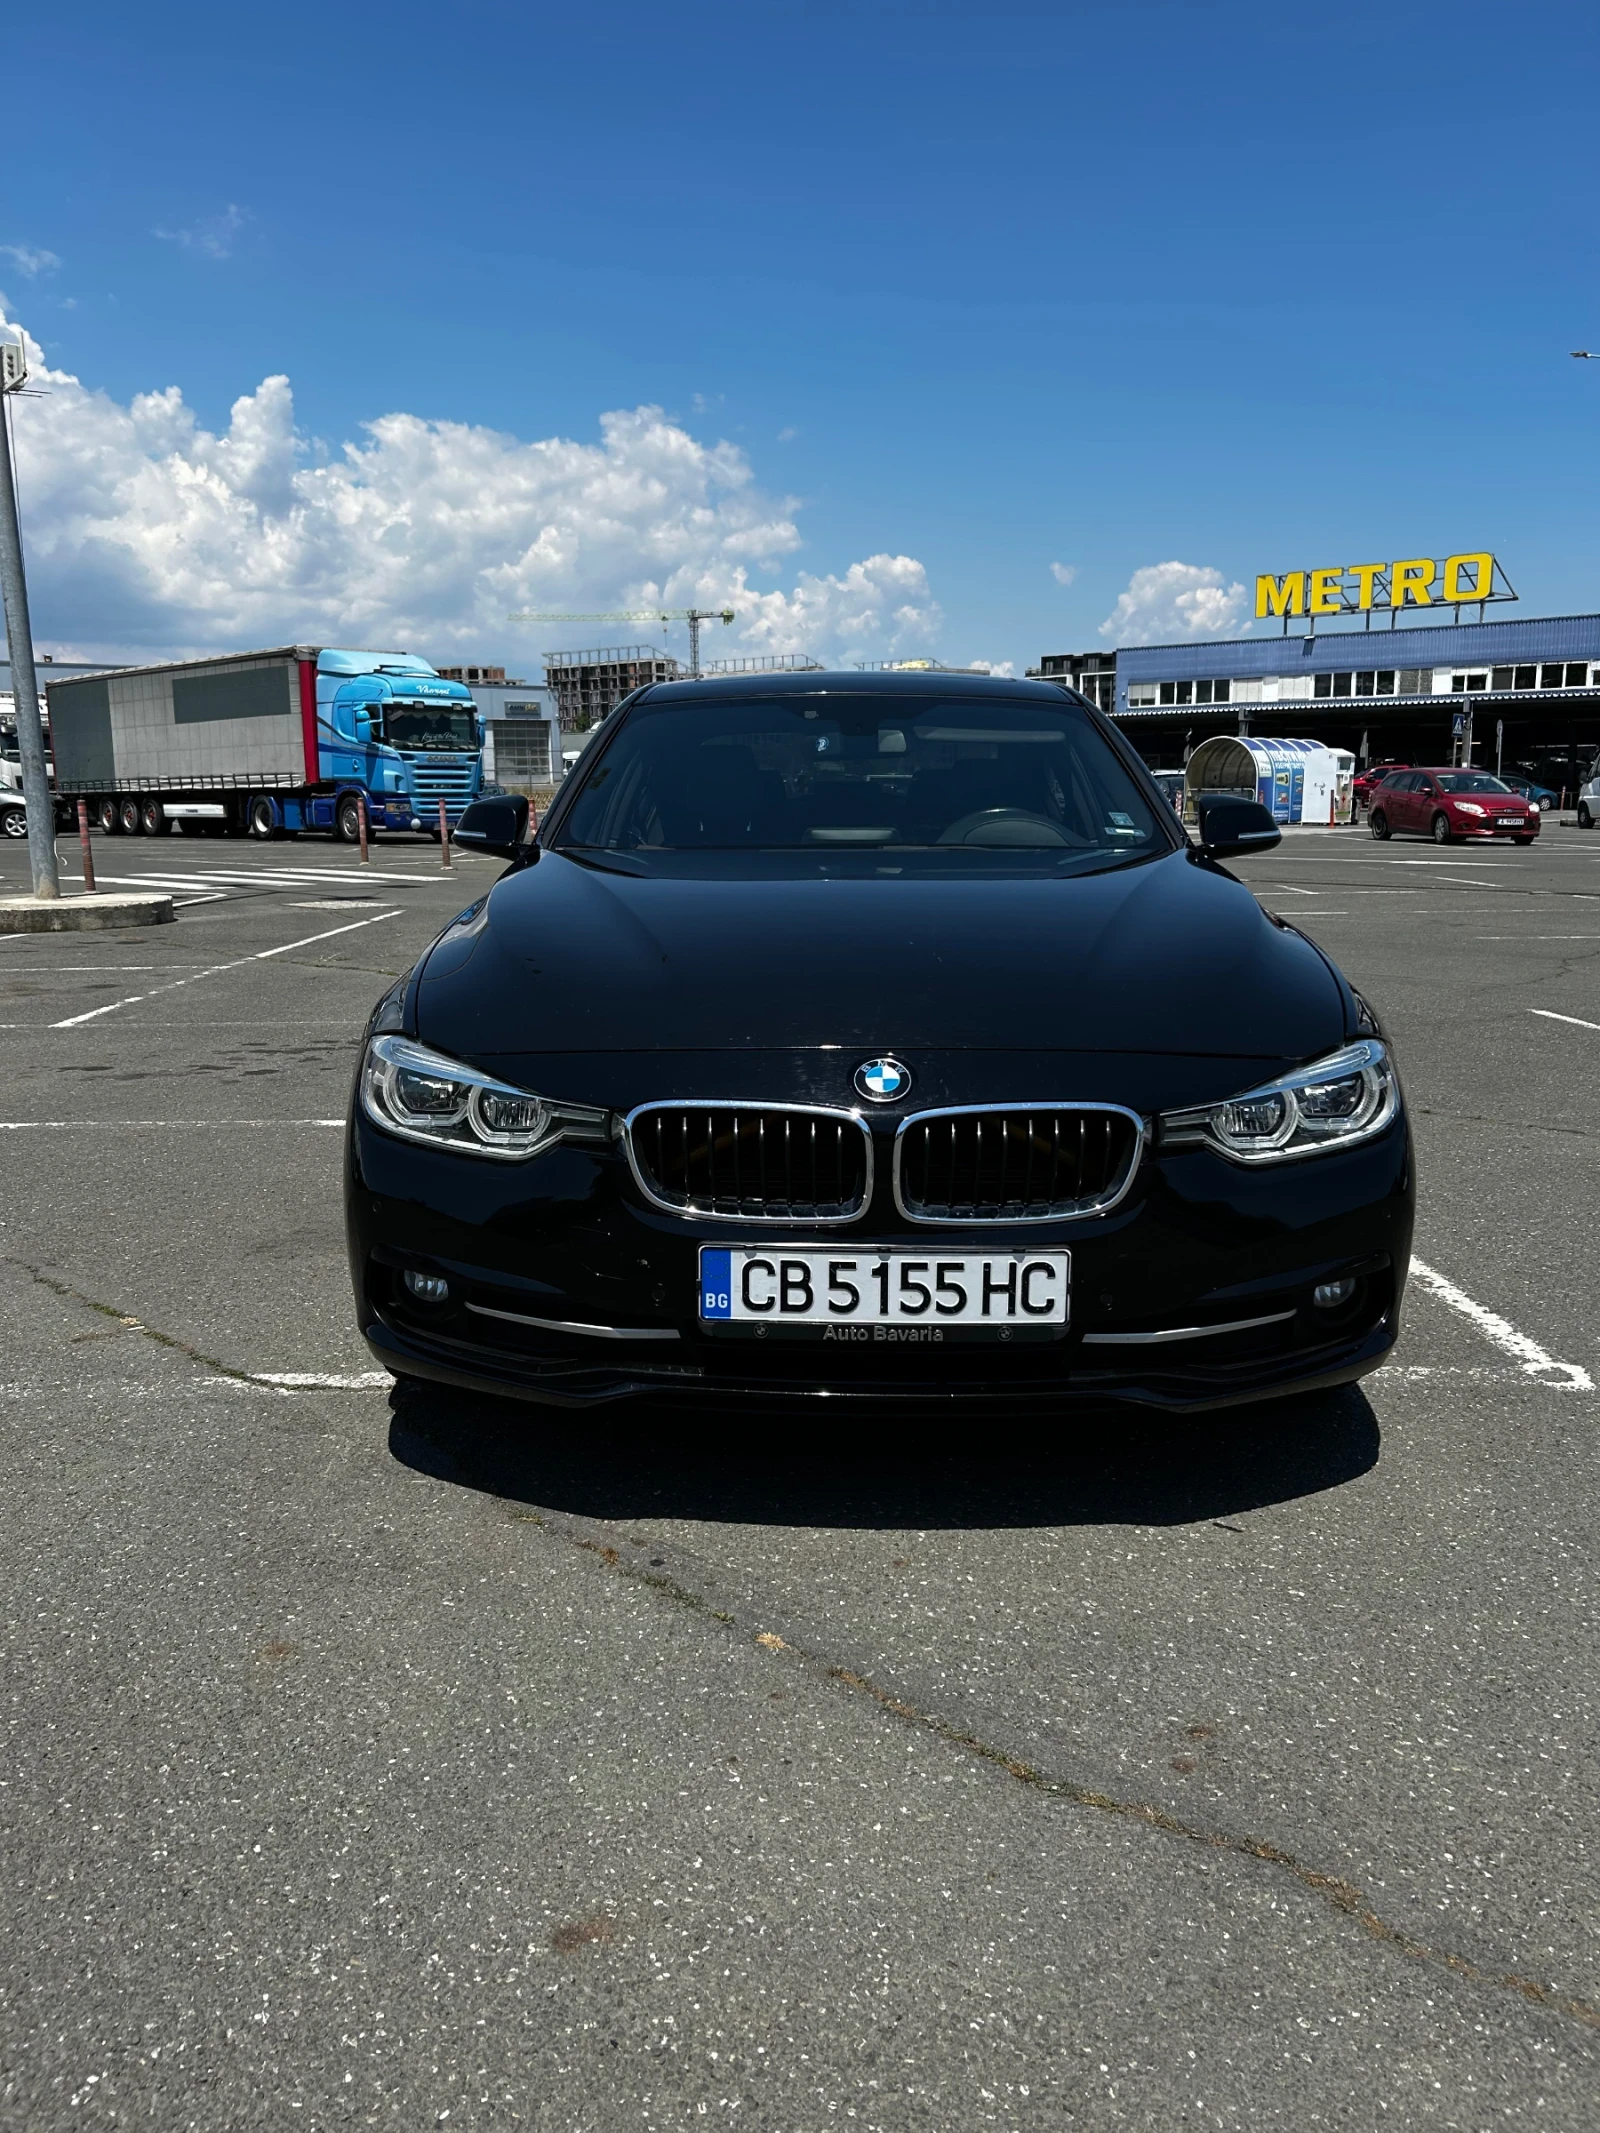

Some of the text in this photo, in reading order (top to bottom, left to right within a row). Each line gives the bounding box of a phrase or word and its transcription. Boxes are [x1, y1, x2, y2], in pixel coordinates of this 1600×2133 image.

[1255, 552, 1495, 618] METRO
[860, 1060, 906, 1073] BMW
[741, 1259, 1055, 1316] CB 5155 HC
[705, 1293, 728, 1309] BG
[823, 1325, 944, 1342] Auto Bavaria
